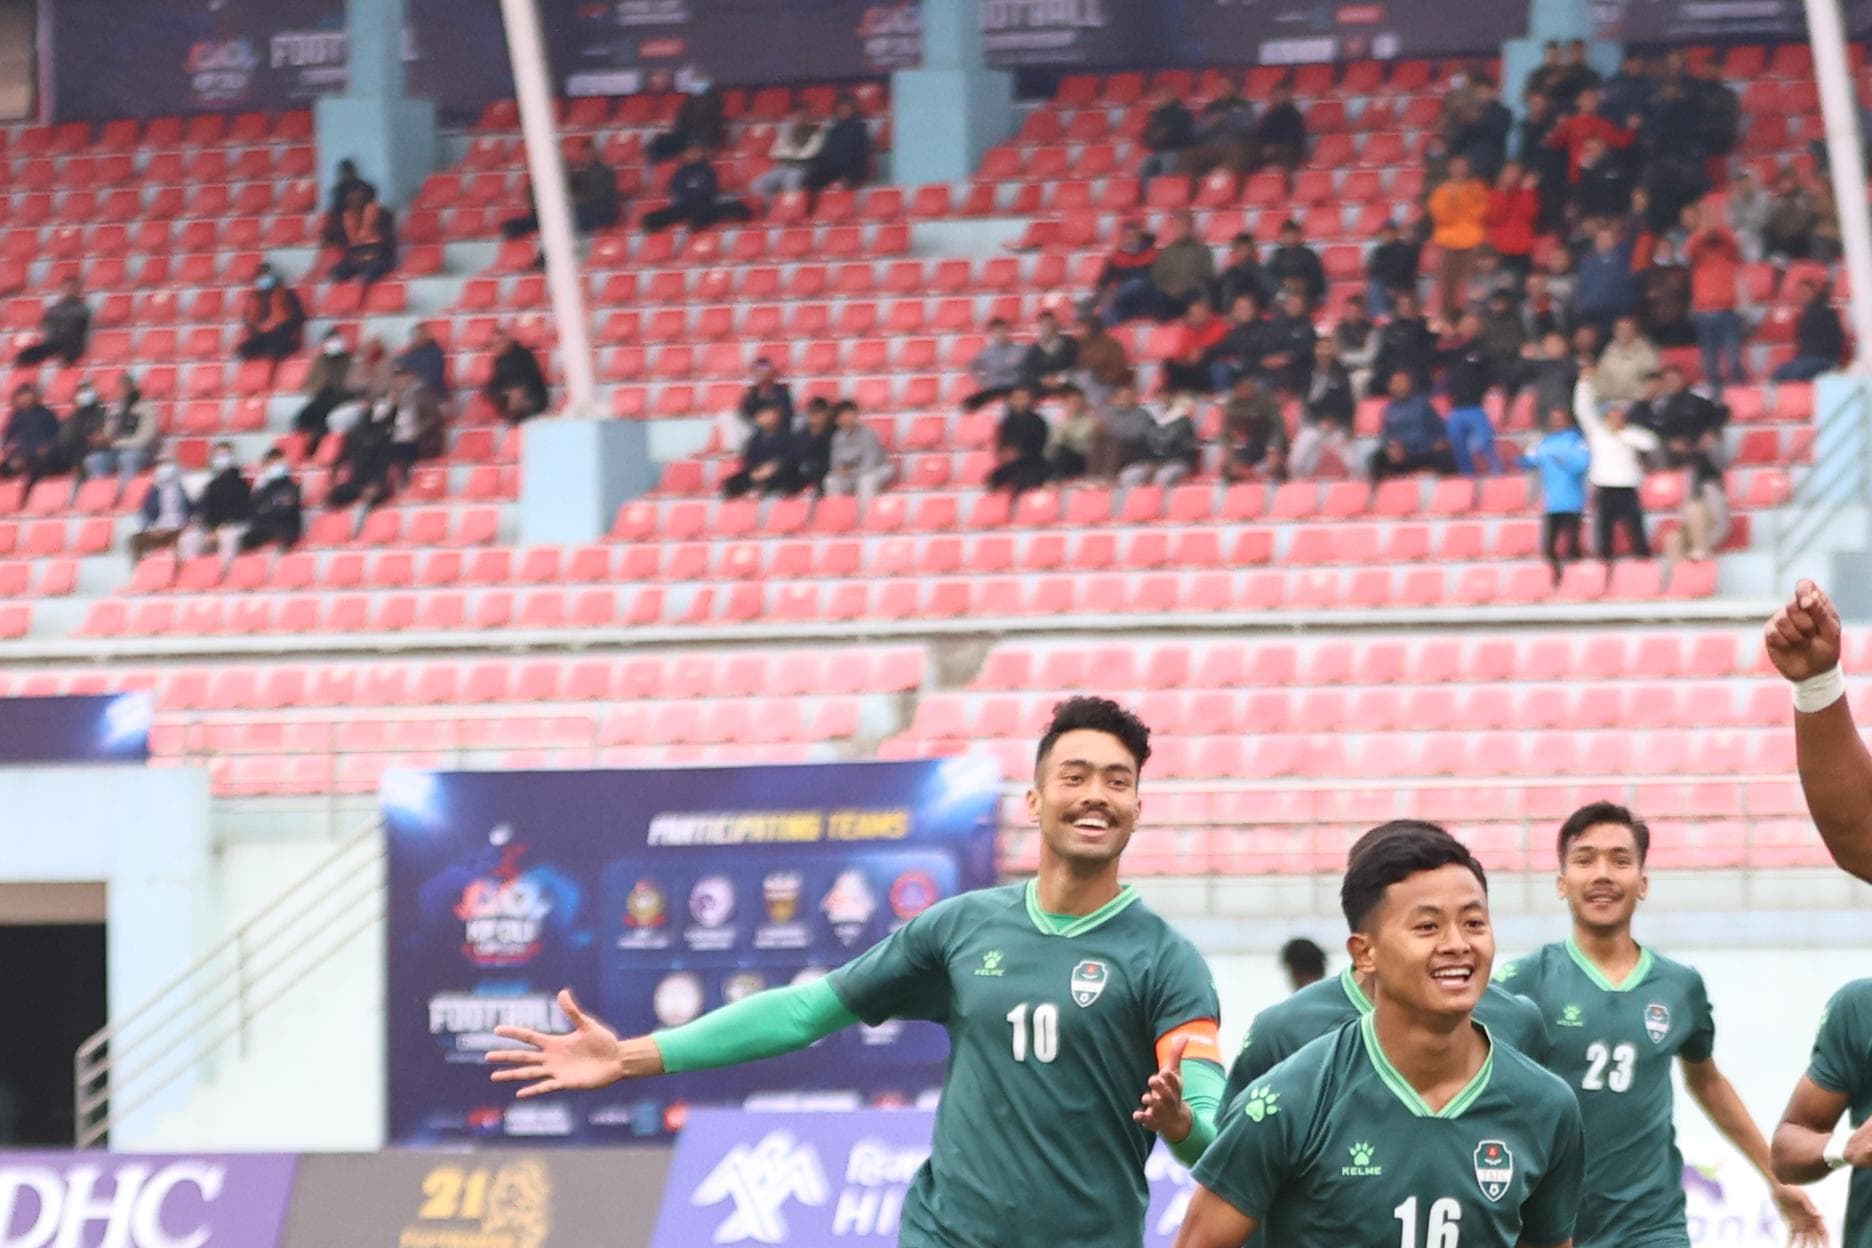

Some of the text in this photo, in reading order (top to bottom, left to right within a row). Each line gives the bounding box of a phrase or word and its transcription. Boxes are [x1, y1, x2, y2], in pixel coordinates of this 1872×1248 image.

[827, 808, 908, 841] TEAMS
[1006, 1002, 1057, 1063] 10
[1582, 1042, 1636, 1093] 23
[1342, 1166, 1382, 1176] KELME
